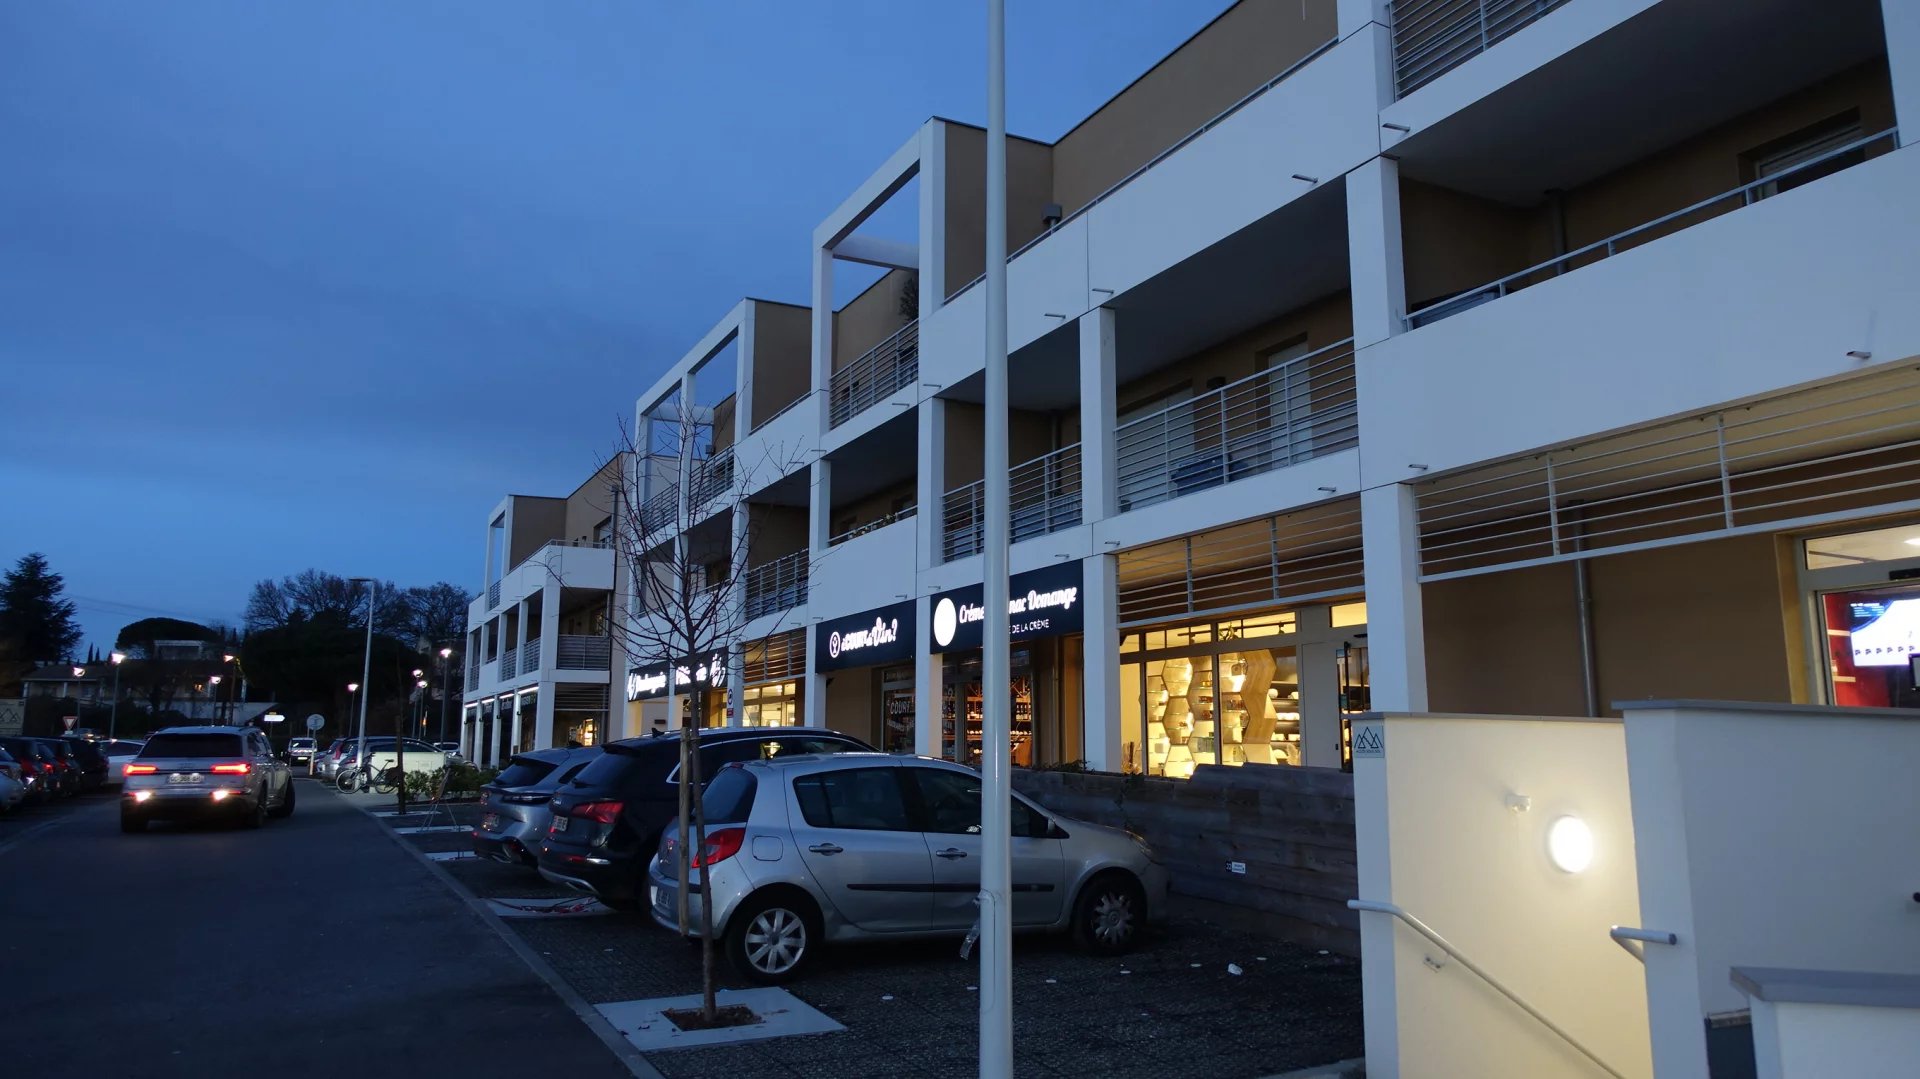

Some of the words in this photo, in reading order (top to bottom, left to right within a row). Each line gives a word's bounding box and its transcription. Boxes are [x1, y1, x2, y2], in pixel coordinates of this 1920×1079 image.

[1027, 586, 1077, 610] Domange
[1012, 624, 1020, 634] DE
[1021, 621, 1029, 632] LA
[1029, 618, 1050, 631] CRÈME
